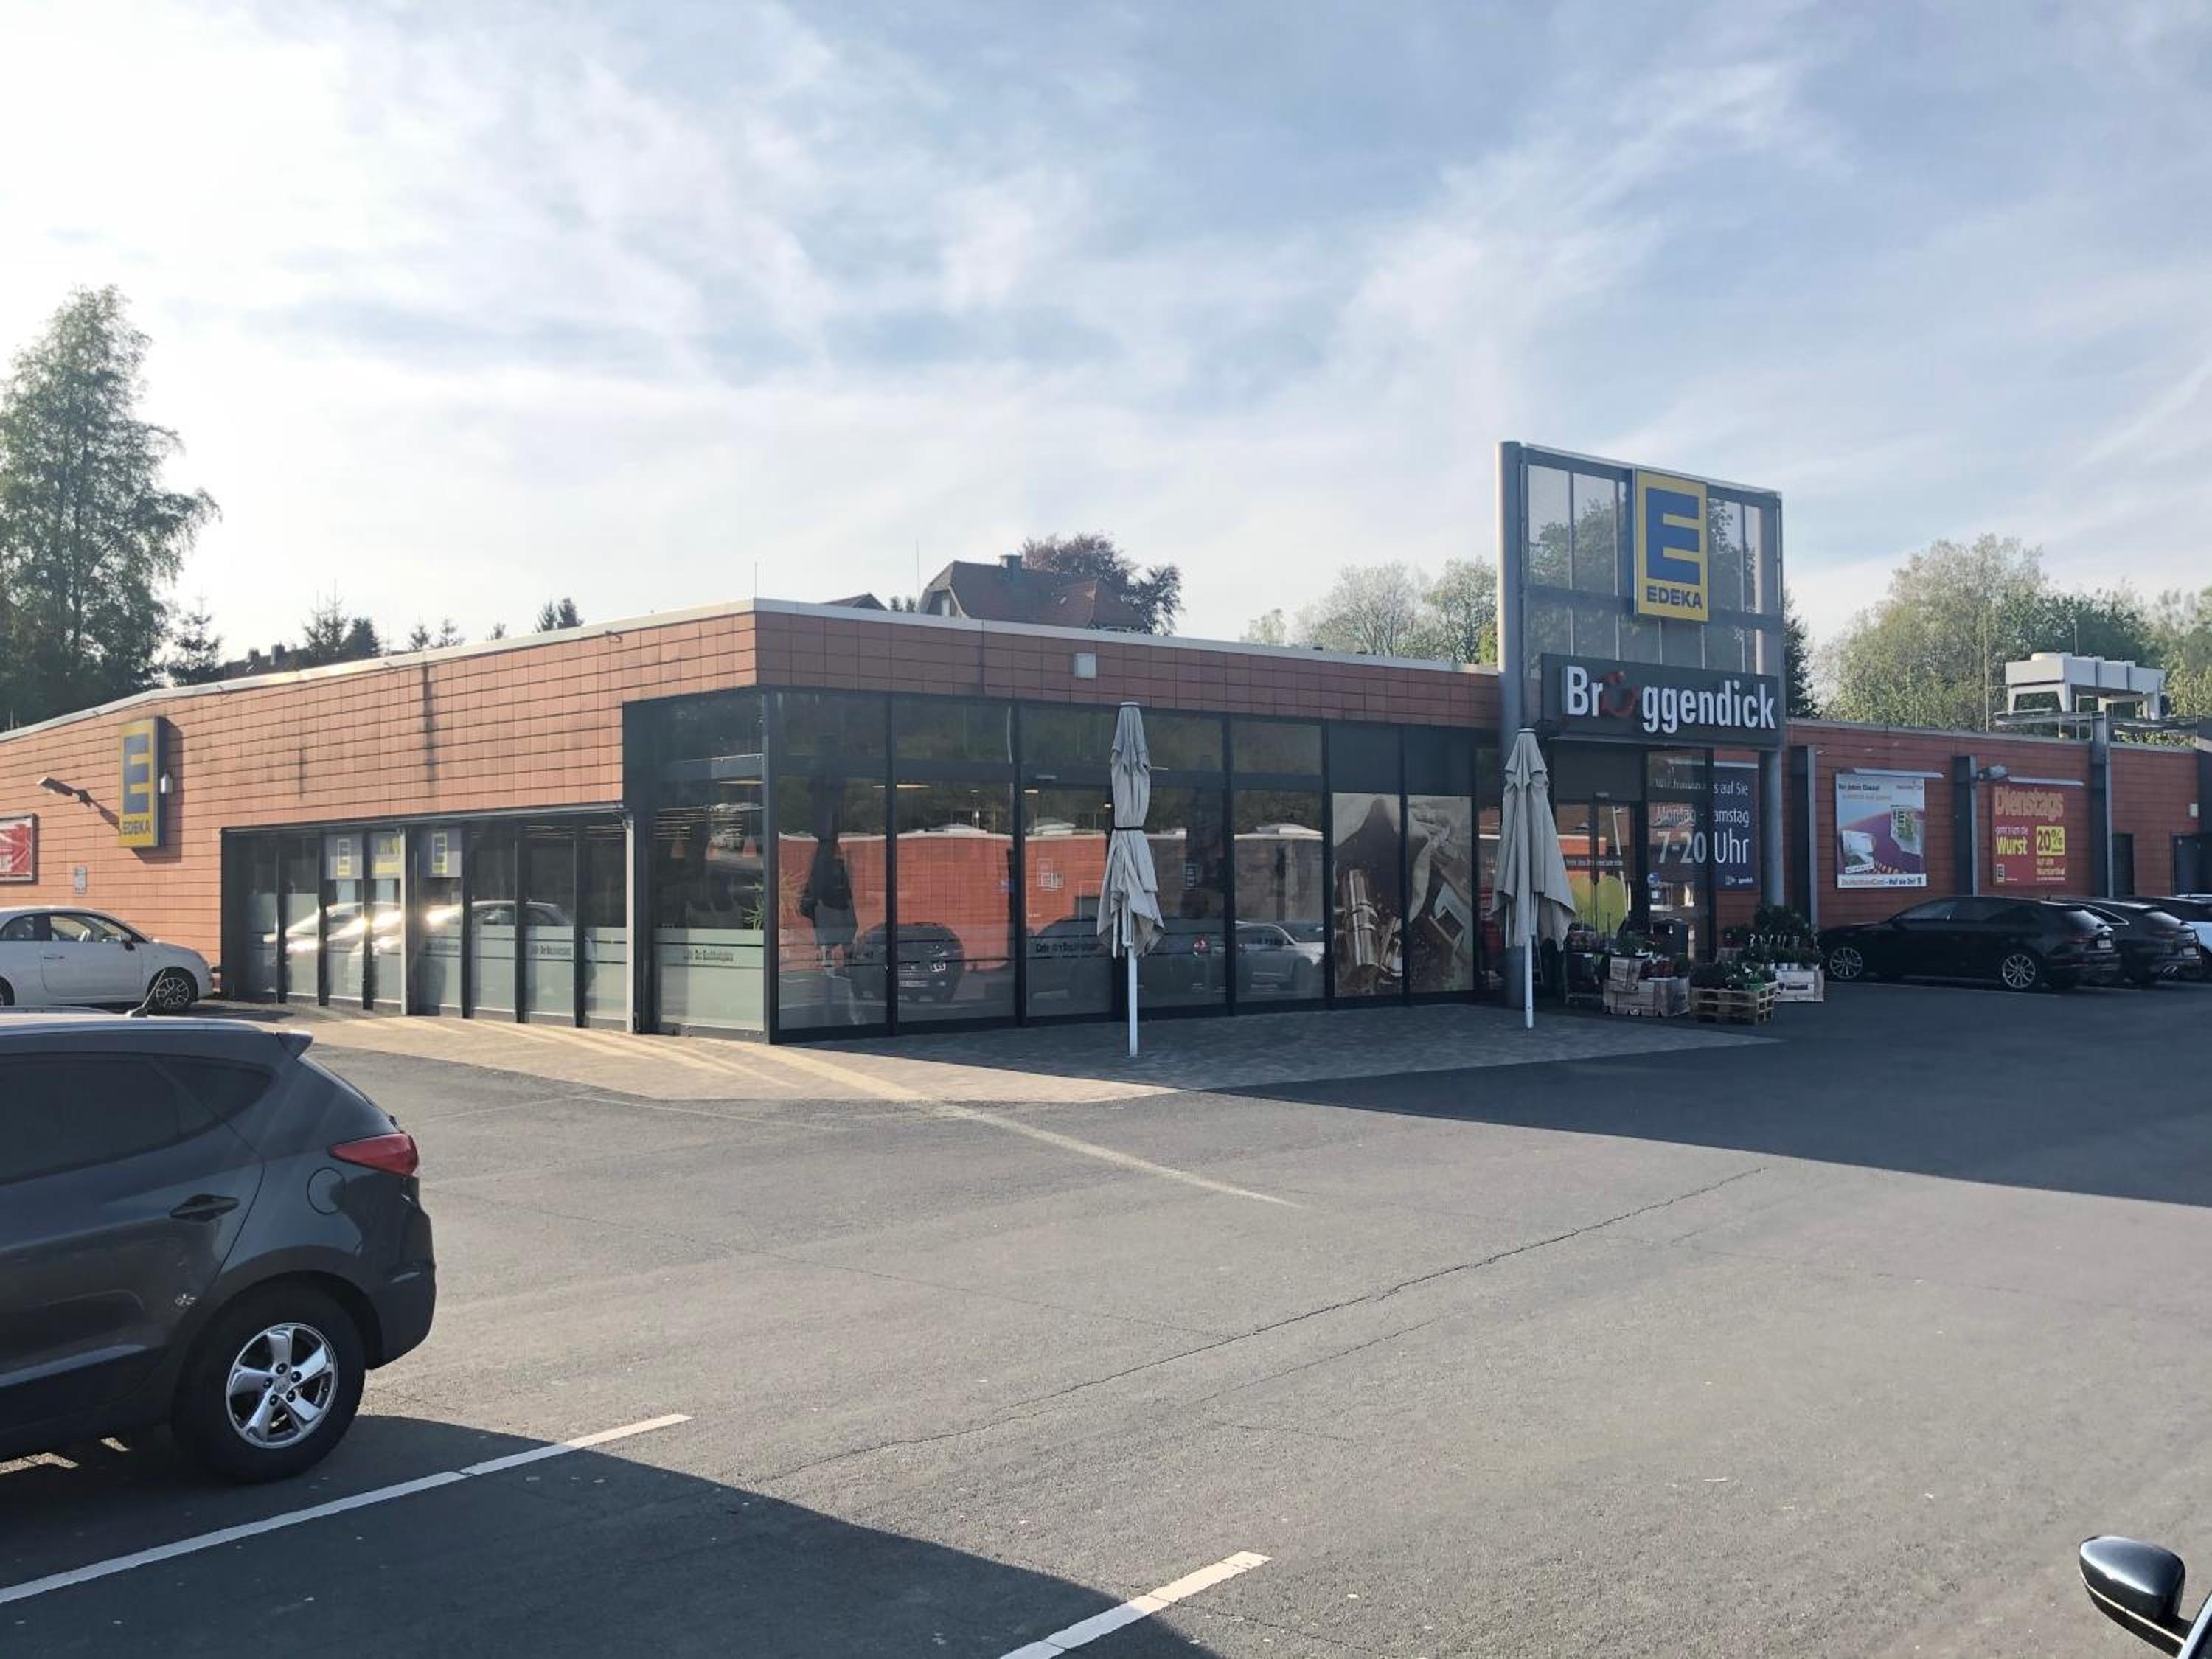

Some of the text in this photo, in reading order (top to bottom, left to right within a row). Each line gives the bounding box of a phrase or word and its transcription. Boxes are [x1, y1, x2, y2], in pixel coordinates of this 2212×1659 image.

[1646, 487, 1700, 585] E
[1646, 585, 1703, 610] EDEKA
[123, 731, 150, 814] E
[1714, 808, 1750, 828] amstag
[1994, 786, 2064, 822] Dienstags
[1714, 828, 1750, 863] Uhr
[1996, 836, 2028, 855] Wurst
